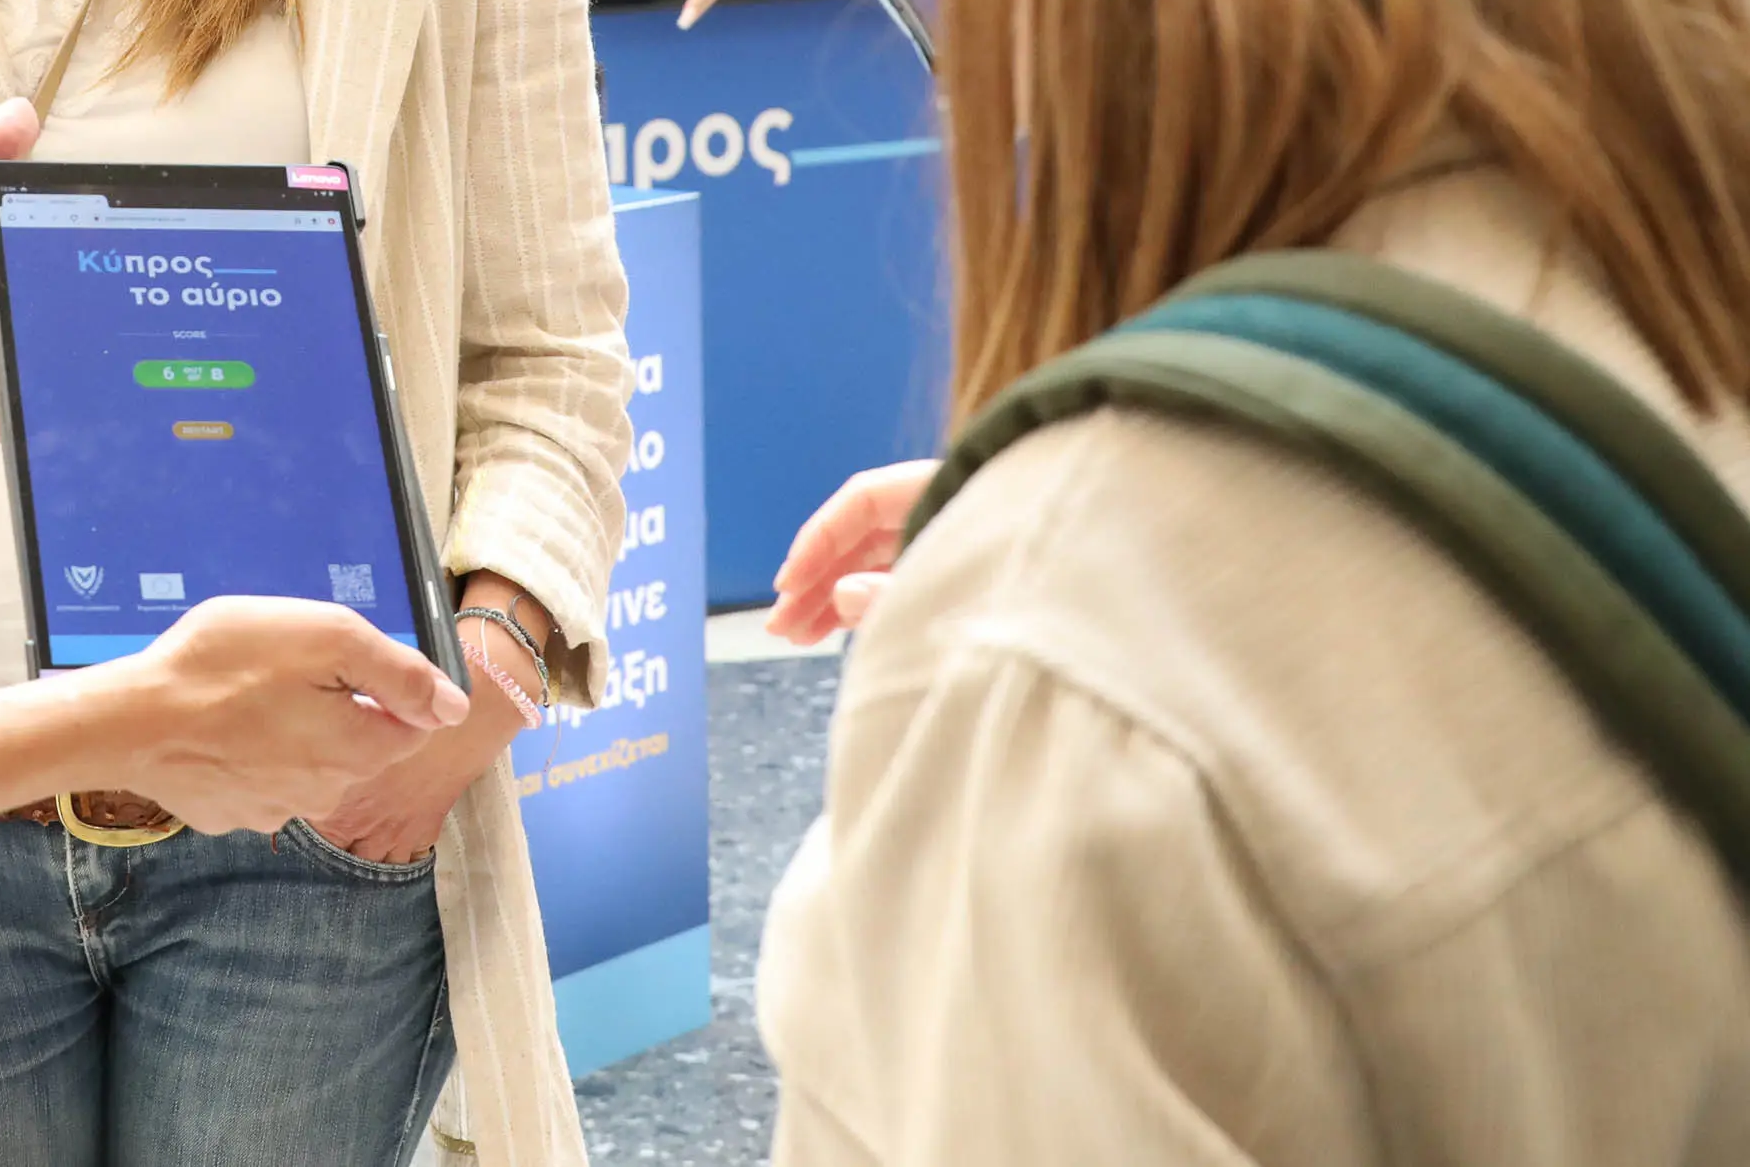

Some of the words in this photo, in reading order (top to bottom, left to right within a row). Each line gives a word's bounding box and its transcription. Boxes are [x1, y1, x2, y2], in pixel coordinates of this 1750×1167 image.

[77, 249, 213, 278] Κύπρος
[129, 286, 170, 306] το
[181, 282, 283, 311] αύριο
